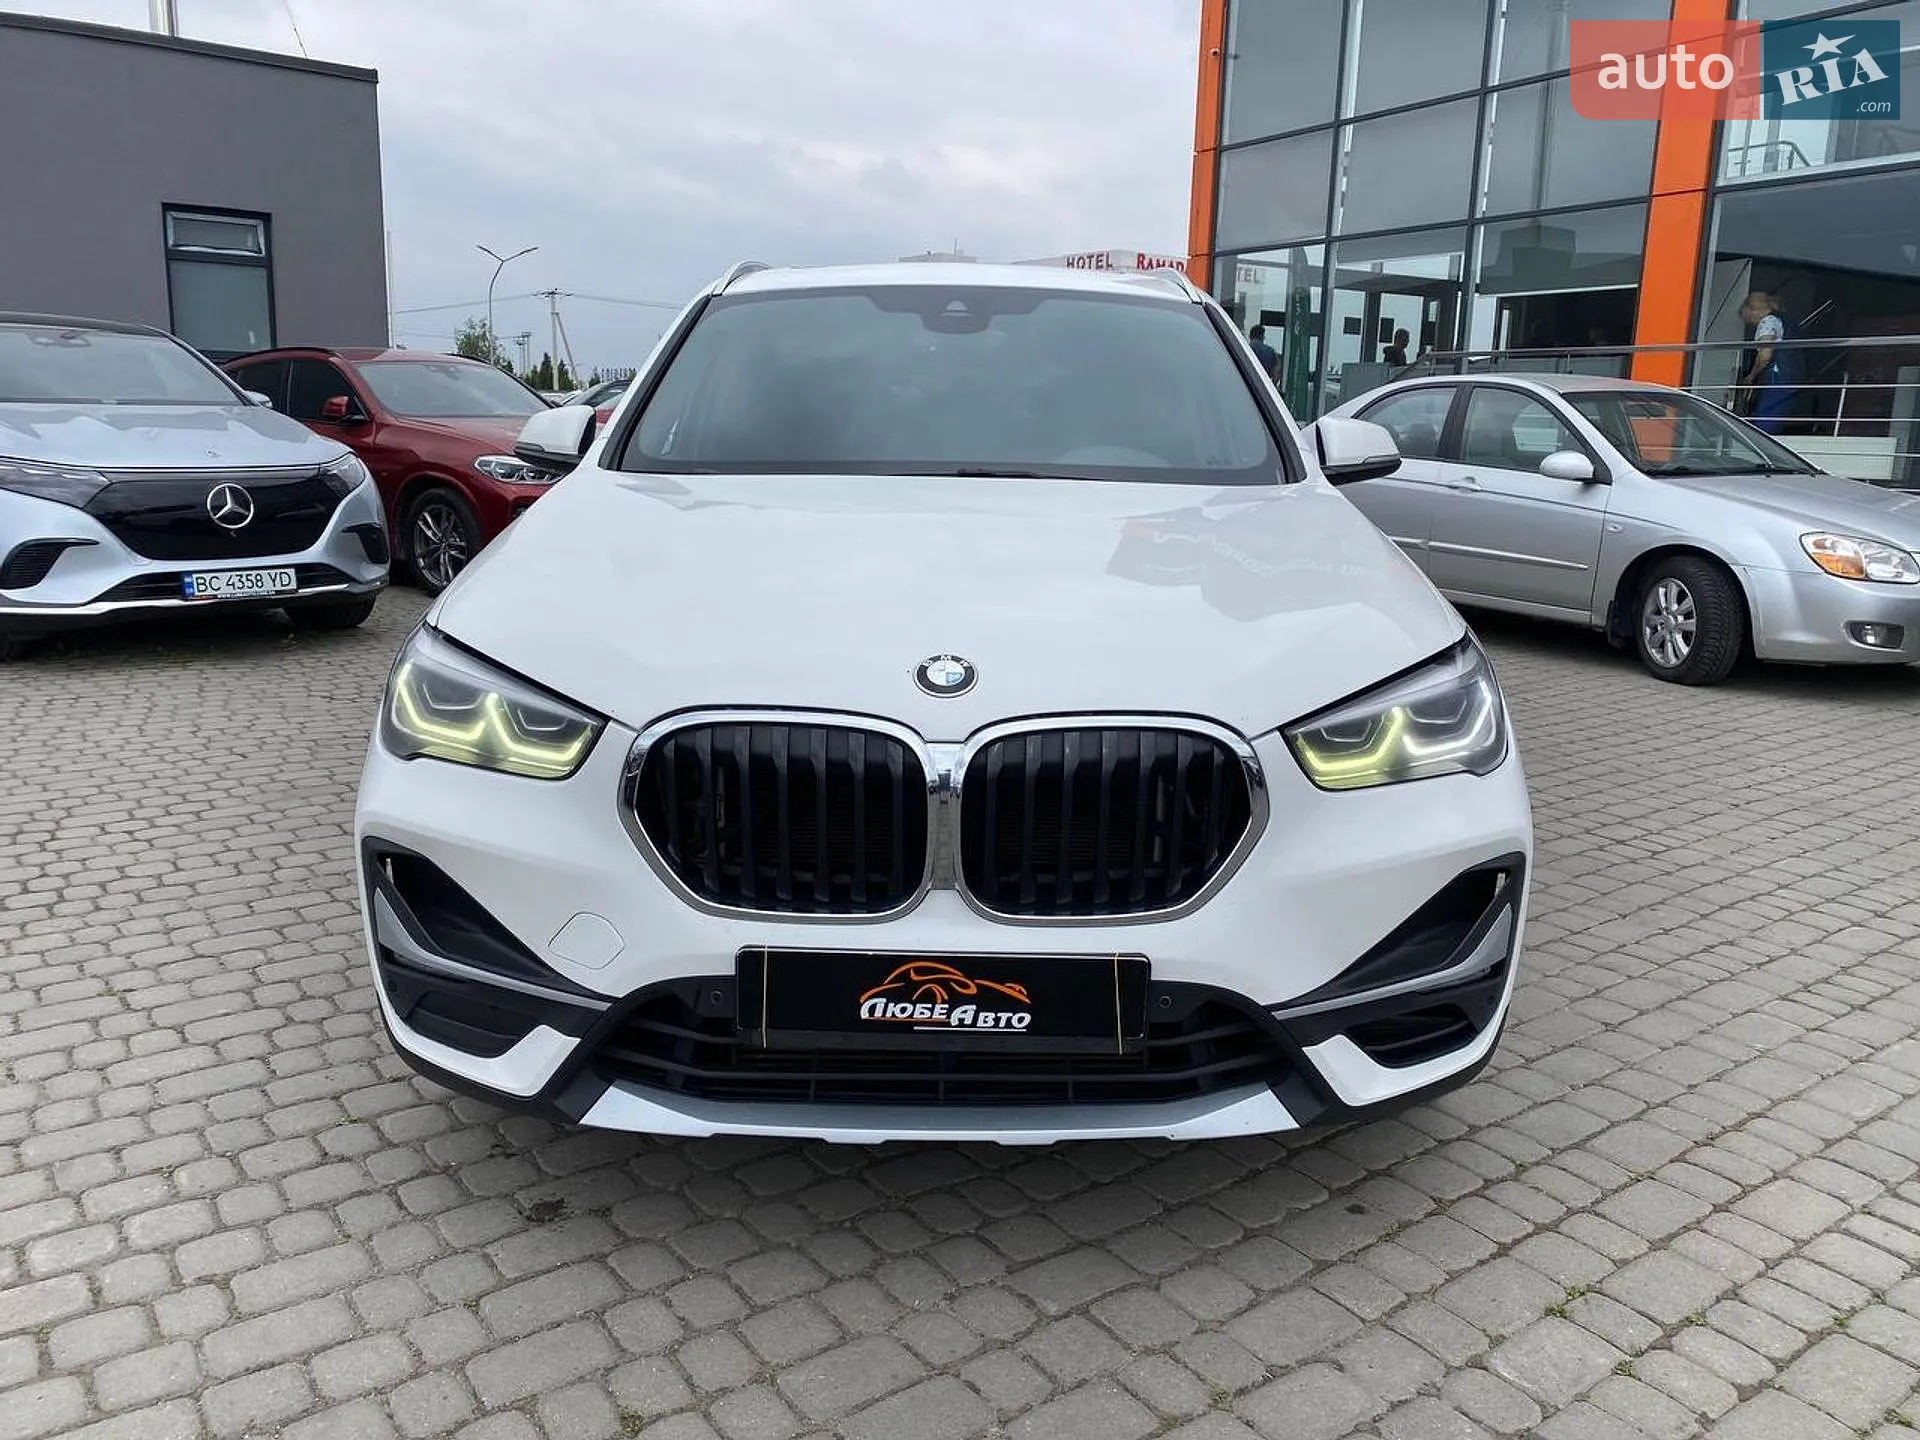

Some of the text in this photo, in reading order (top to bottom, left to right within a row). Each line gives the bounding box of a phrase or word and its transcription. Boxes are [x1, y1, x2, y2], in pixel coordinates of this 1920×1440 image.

[1066, 252, 1113, 270] HOTEL
[195, 575, 221, 593] BC
[226, 572, 264, 591] 4358
[268, 571, 292, 588] YD
